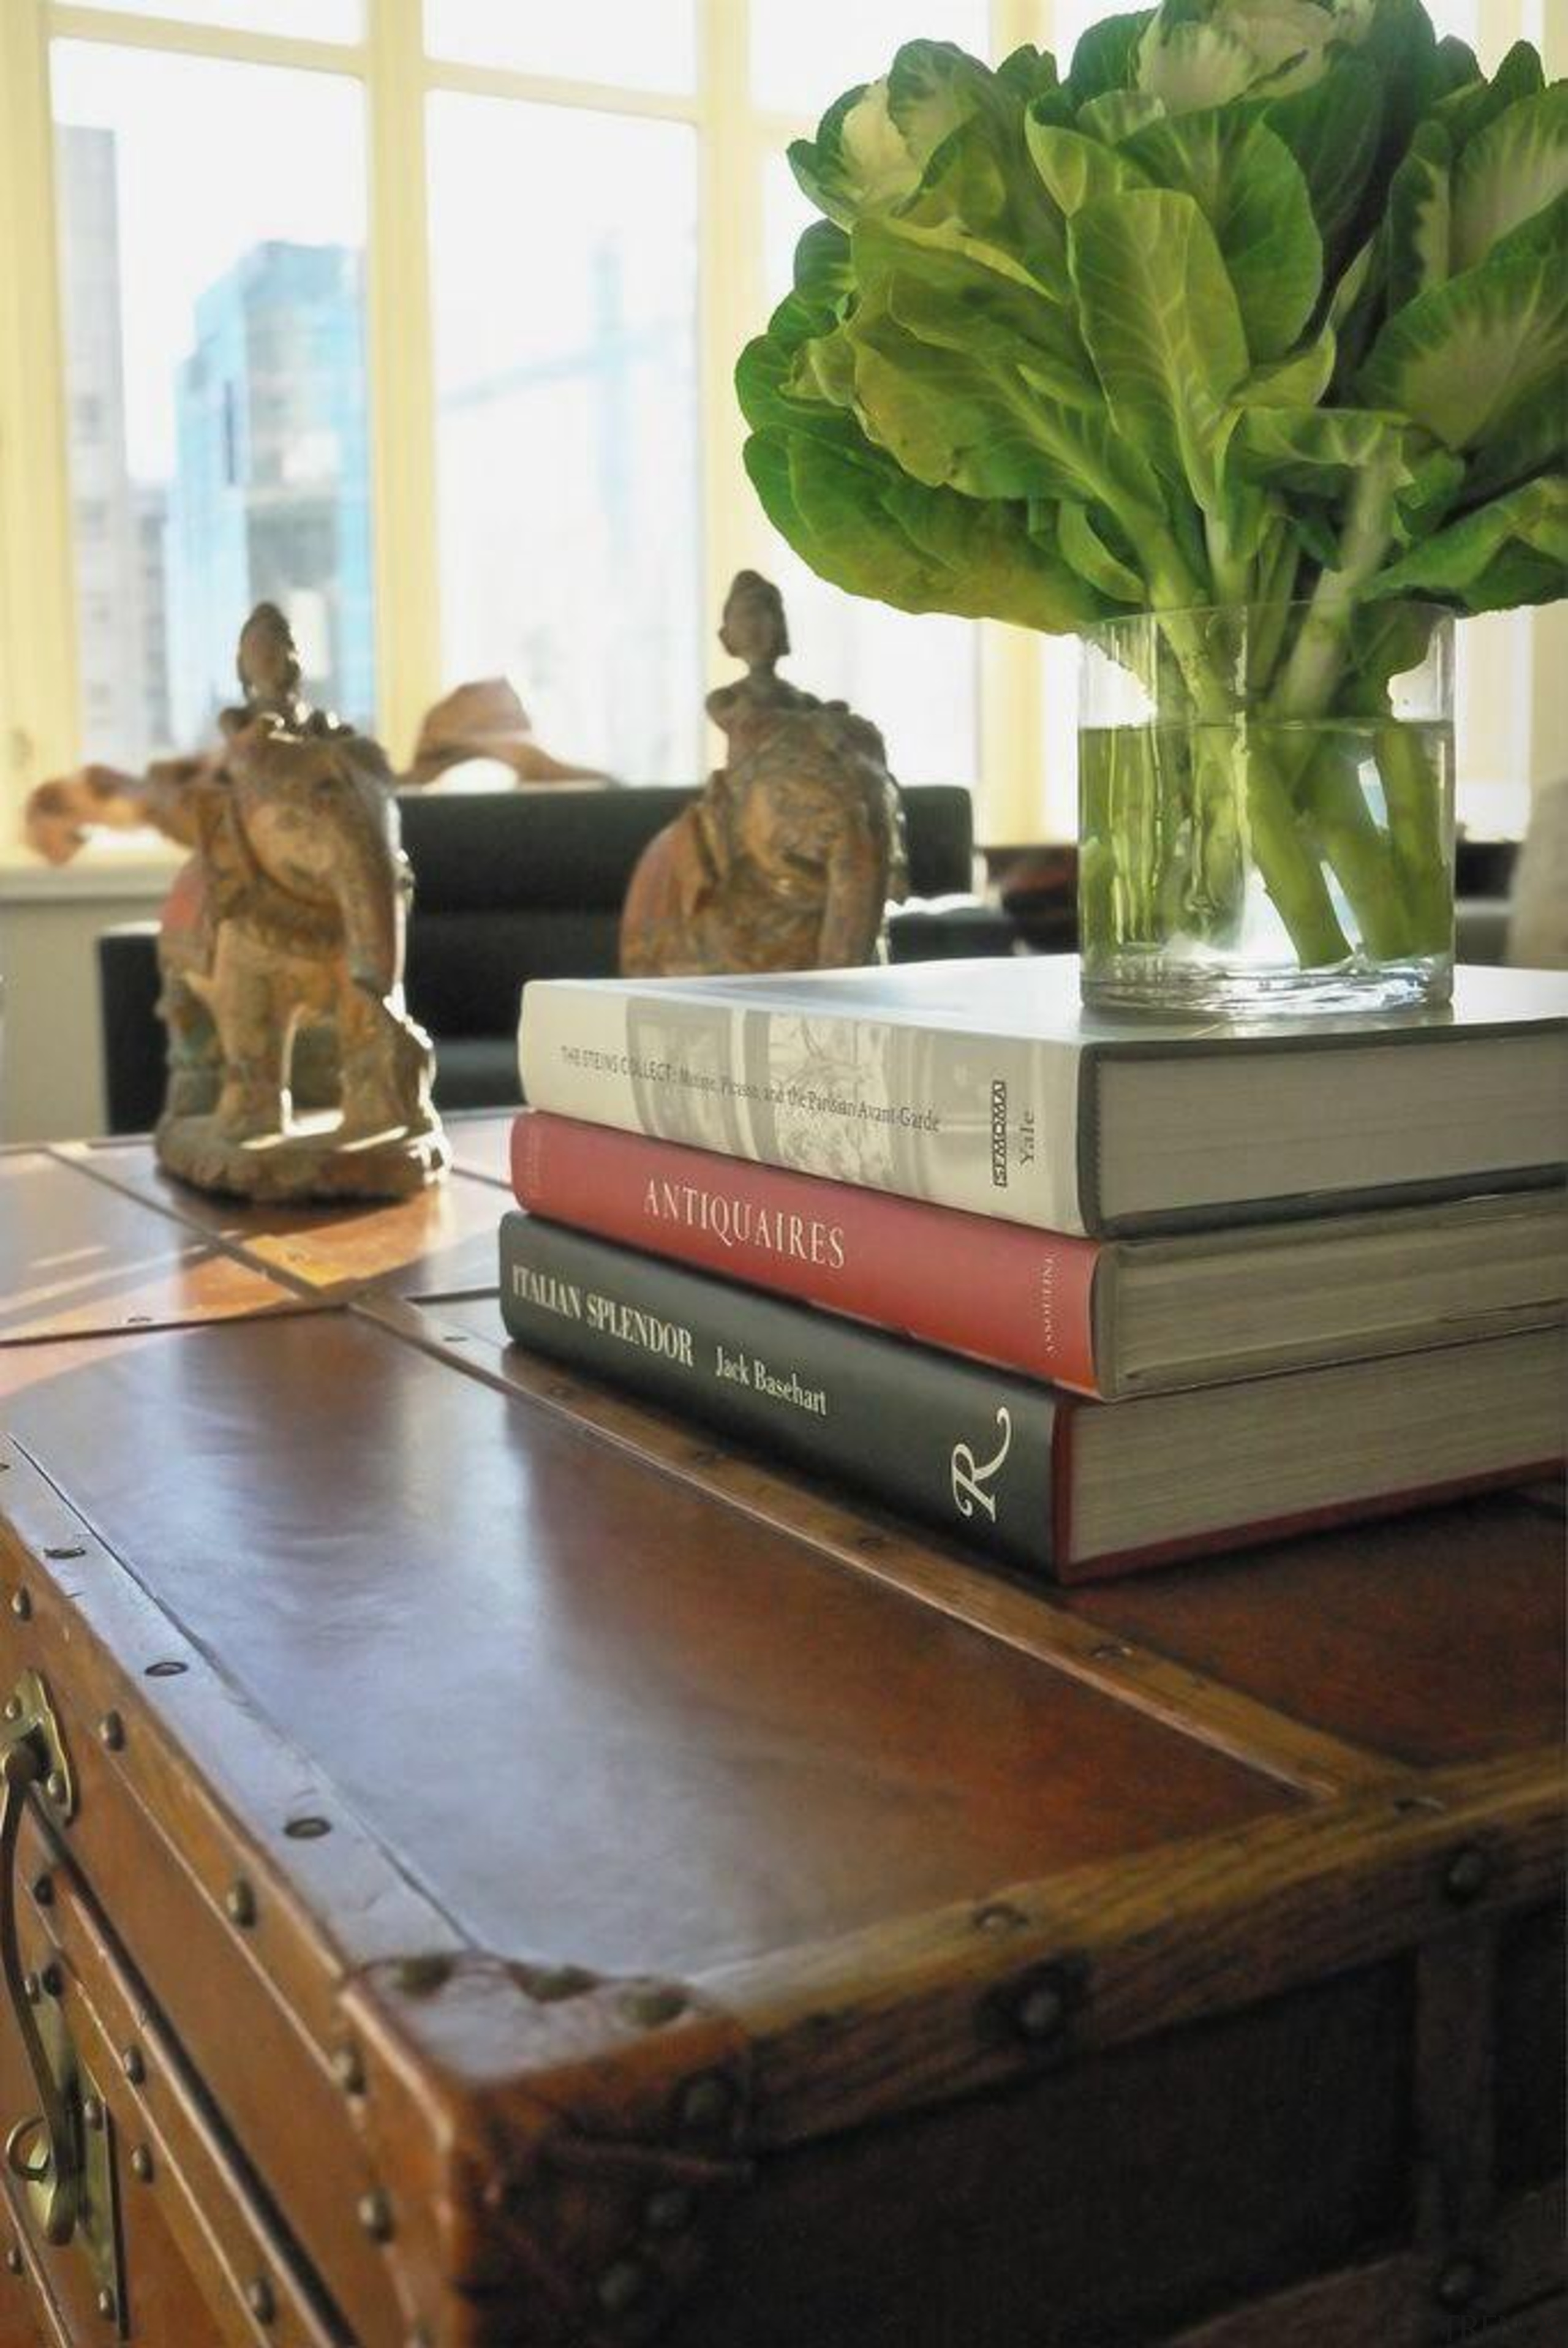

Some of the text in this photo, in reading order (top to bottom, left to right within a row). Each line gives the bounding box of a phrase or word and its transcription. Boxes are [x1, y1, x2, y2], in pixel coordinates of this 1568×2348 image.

[1019, 1109, 1035, 1165] Yale
[644, 1178, 845, 1269] ANTIQUAIRES
[512, 1264, 826, 1415] ITALIAN SPLENDOR Jack Basehart
